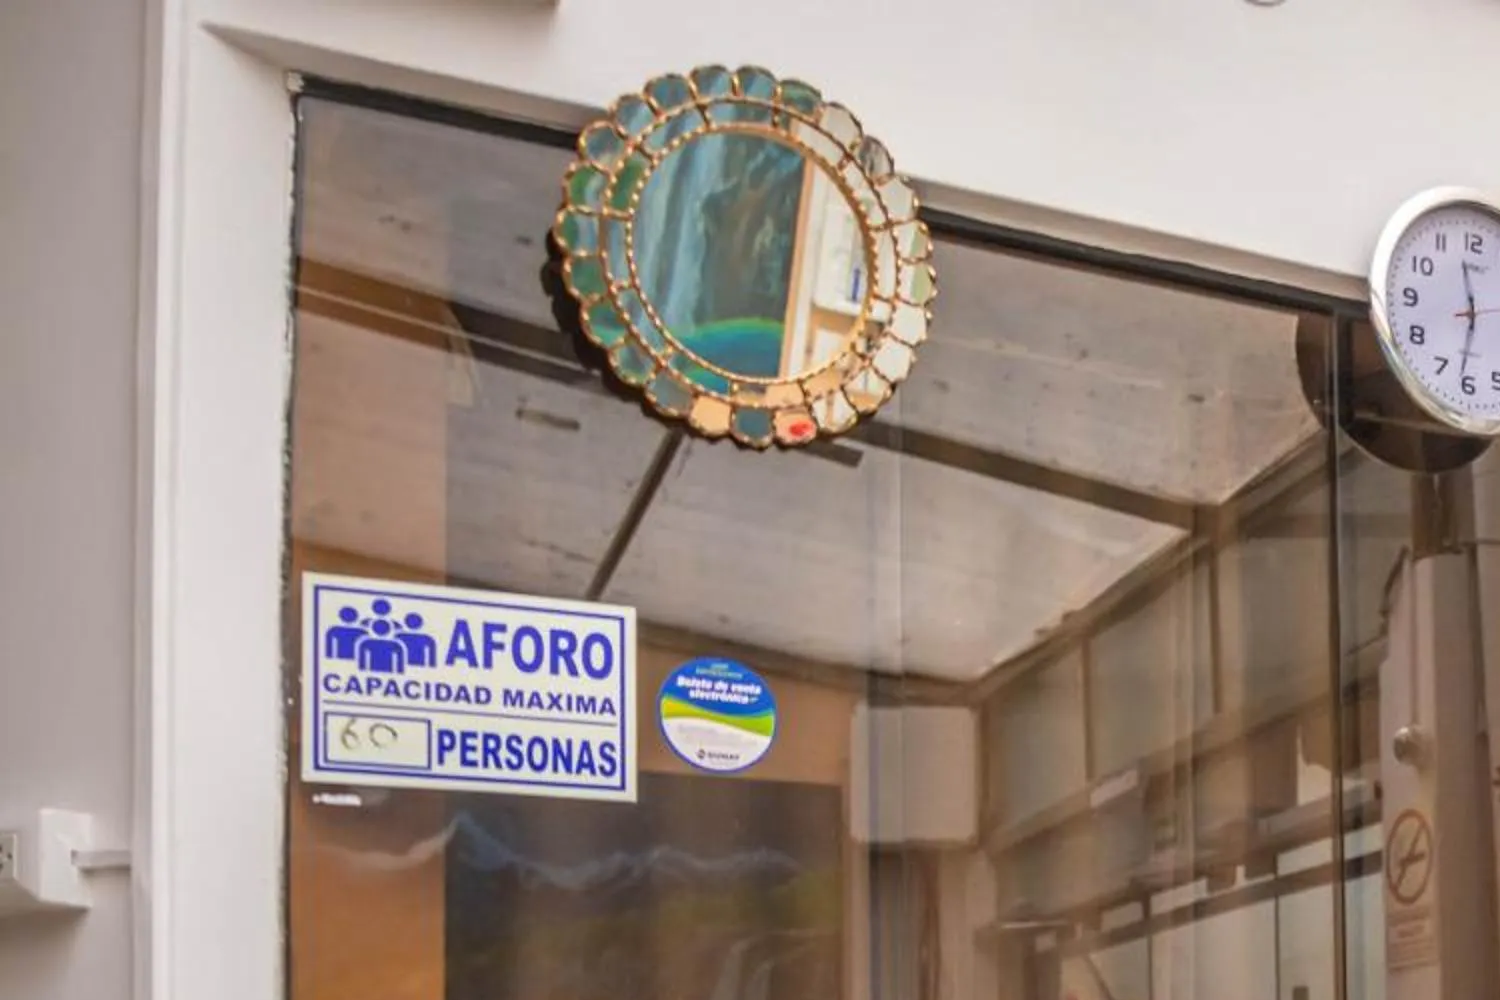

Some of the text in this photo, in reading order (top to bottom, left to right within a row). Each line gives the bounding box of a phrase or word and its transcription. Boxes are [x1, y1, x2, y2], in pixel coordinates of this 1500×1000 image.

[1435, 233, 1446, 252] 11
[1464, 232, 1483, 254] 12
[1412, 256, 1433, 276] 10
[1403, 287, 1419, 307] 9
[1409, 325, 1425, 345] 8
[1433, 356, 1448, 376] 7
[1461, 376, 1476, 395] 6
[445, 619, 615, 680] AFORO
[323, 673, 617, 717] CAPACIDAD MAXIMA
[340, 718, 398, 751] 60
[437, 728, 618, 778] PERSONAS
